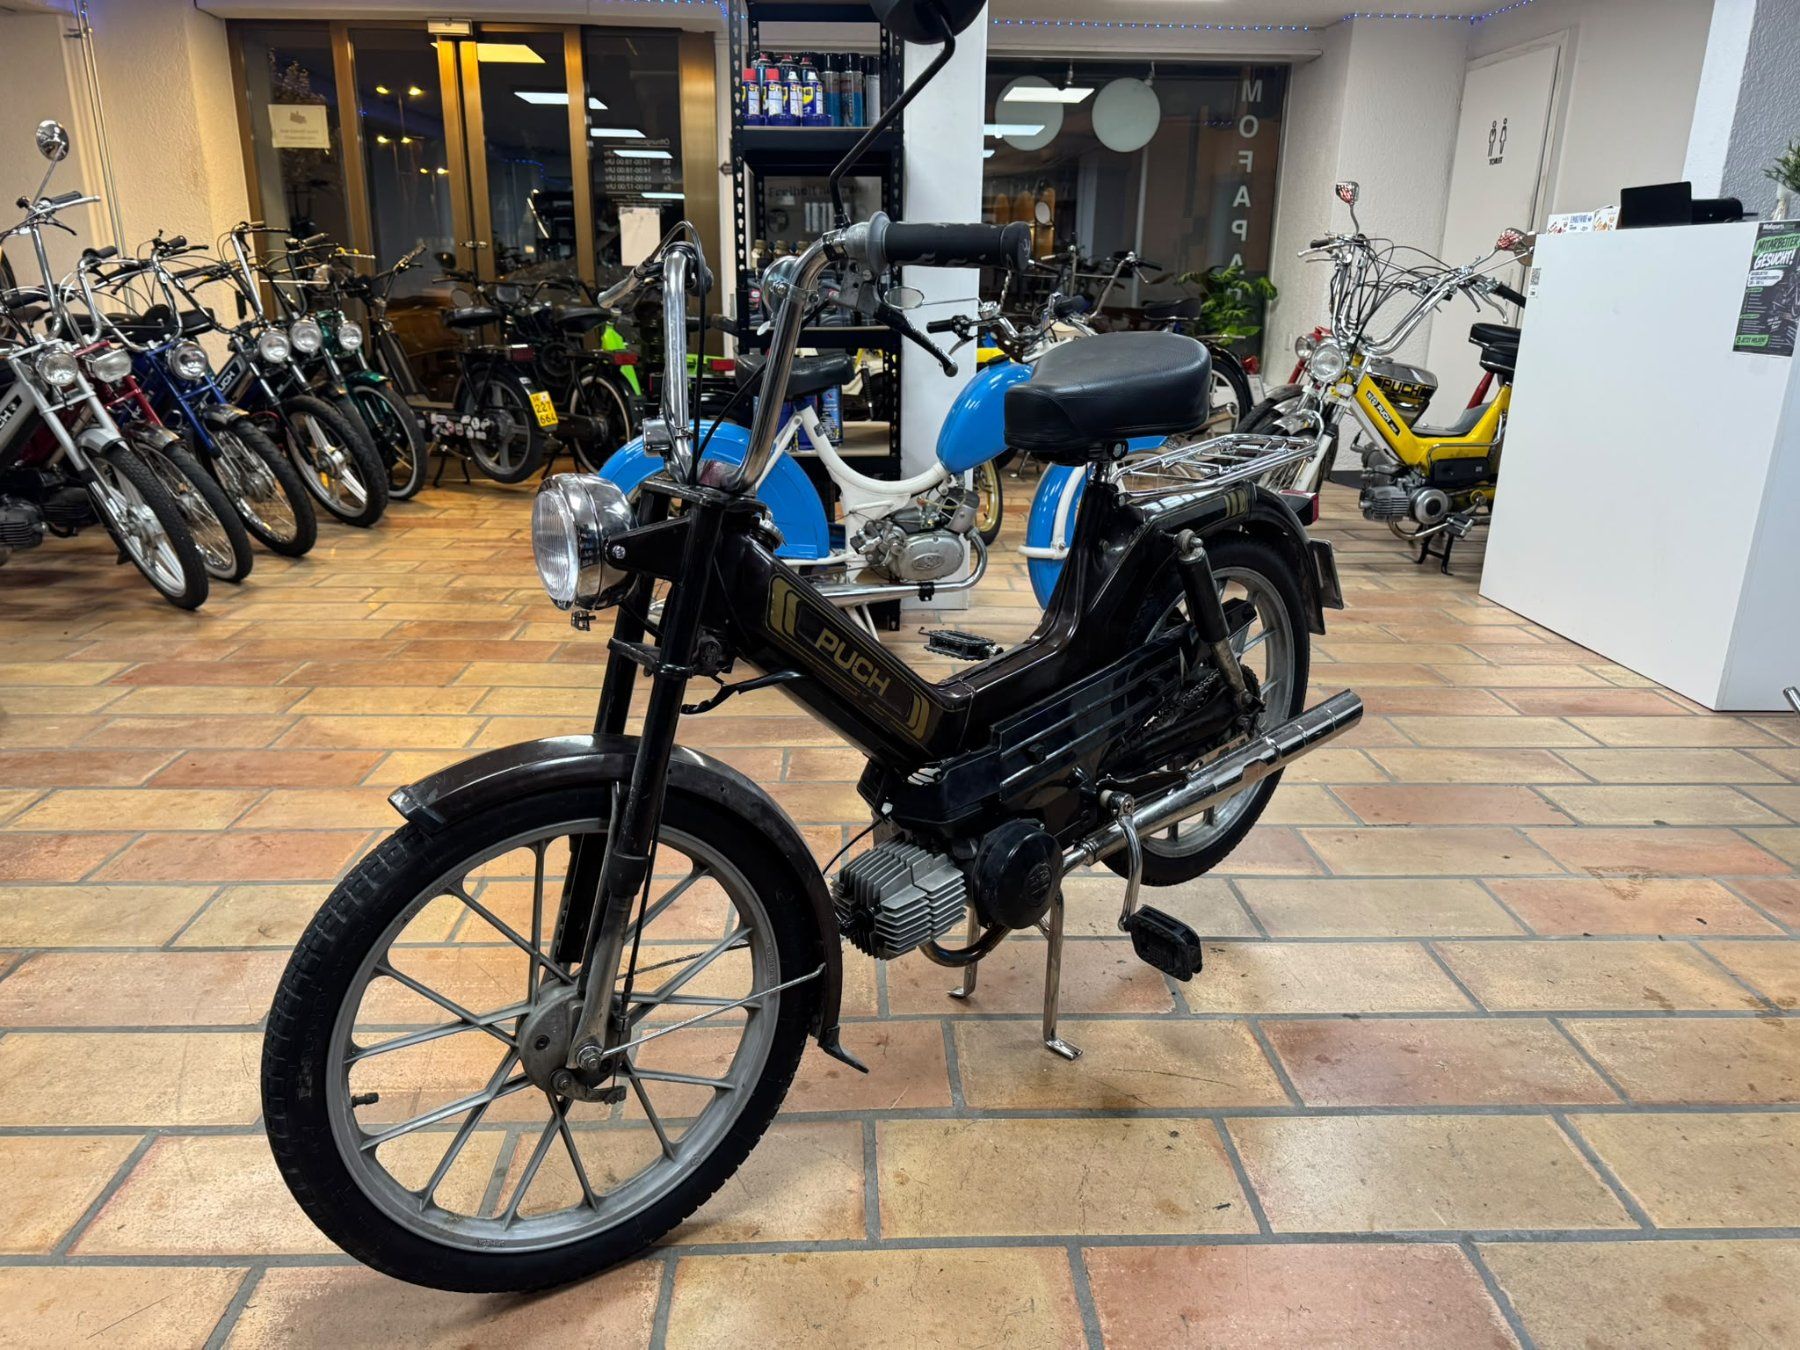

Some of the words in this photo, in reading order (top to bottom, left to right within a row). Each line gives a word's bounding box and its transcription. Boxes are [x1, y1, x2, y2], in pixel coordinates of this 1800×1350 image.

[1756, 235, 1799, 253] MITARBEITER
[1754, 248, 1796, 270] GESUCHT!
[1382, 378, 1421, 397] PUCH
[535, 401, 552, 413] 227
[815, 627, 892, 697] PUCH
